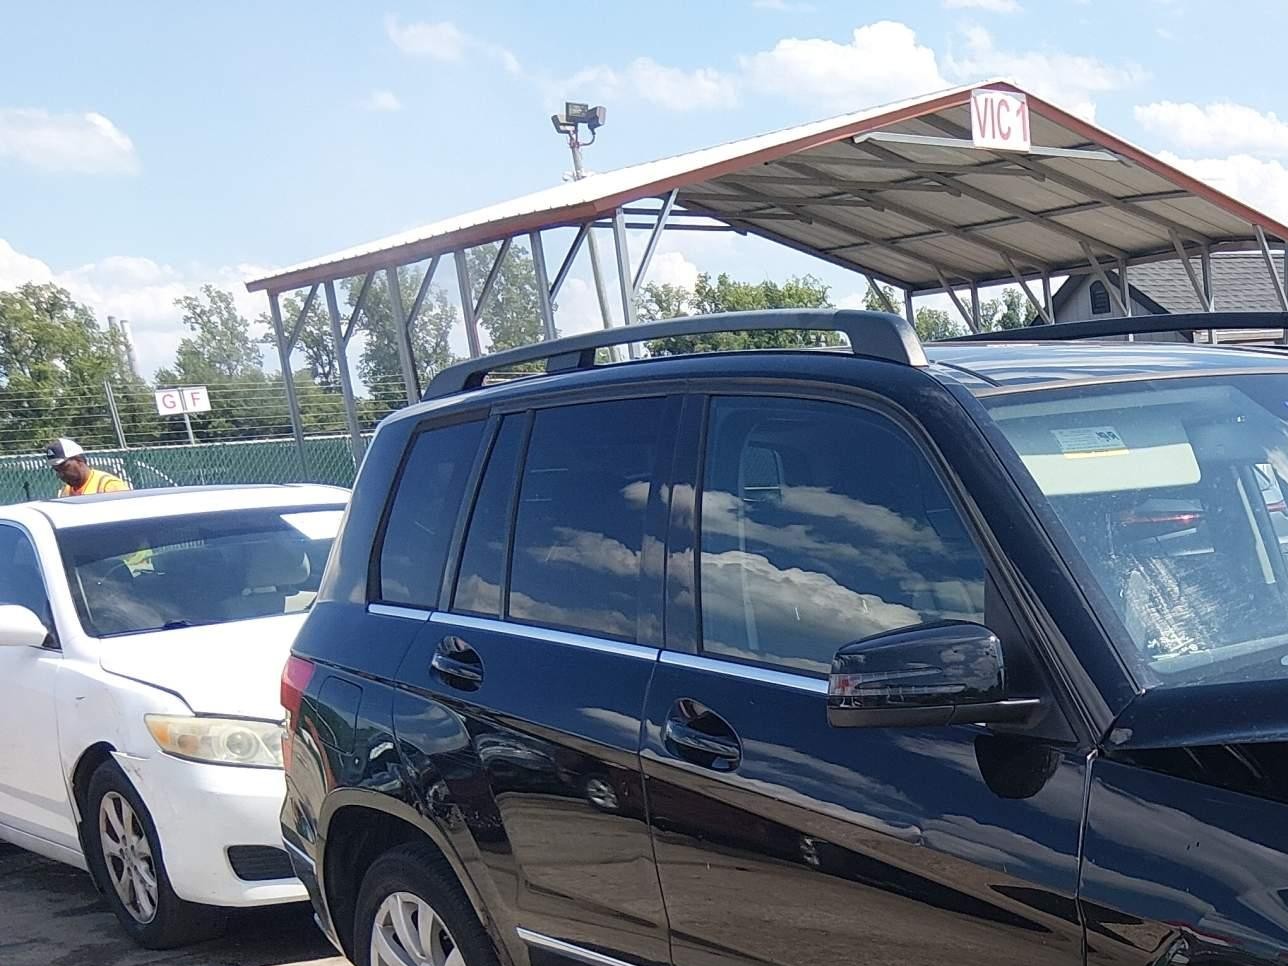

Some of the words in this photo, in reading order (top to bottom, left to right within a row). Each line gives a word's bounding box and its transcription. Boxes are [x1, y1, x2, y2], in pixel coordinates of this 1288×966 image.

[973, 96, 1011, 141] VIC
[1016, 101, 1028, 142] 1
[162, 393, 177, 409] G
[190, 391, 200, 407] F
